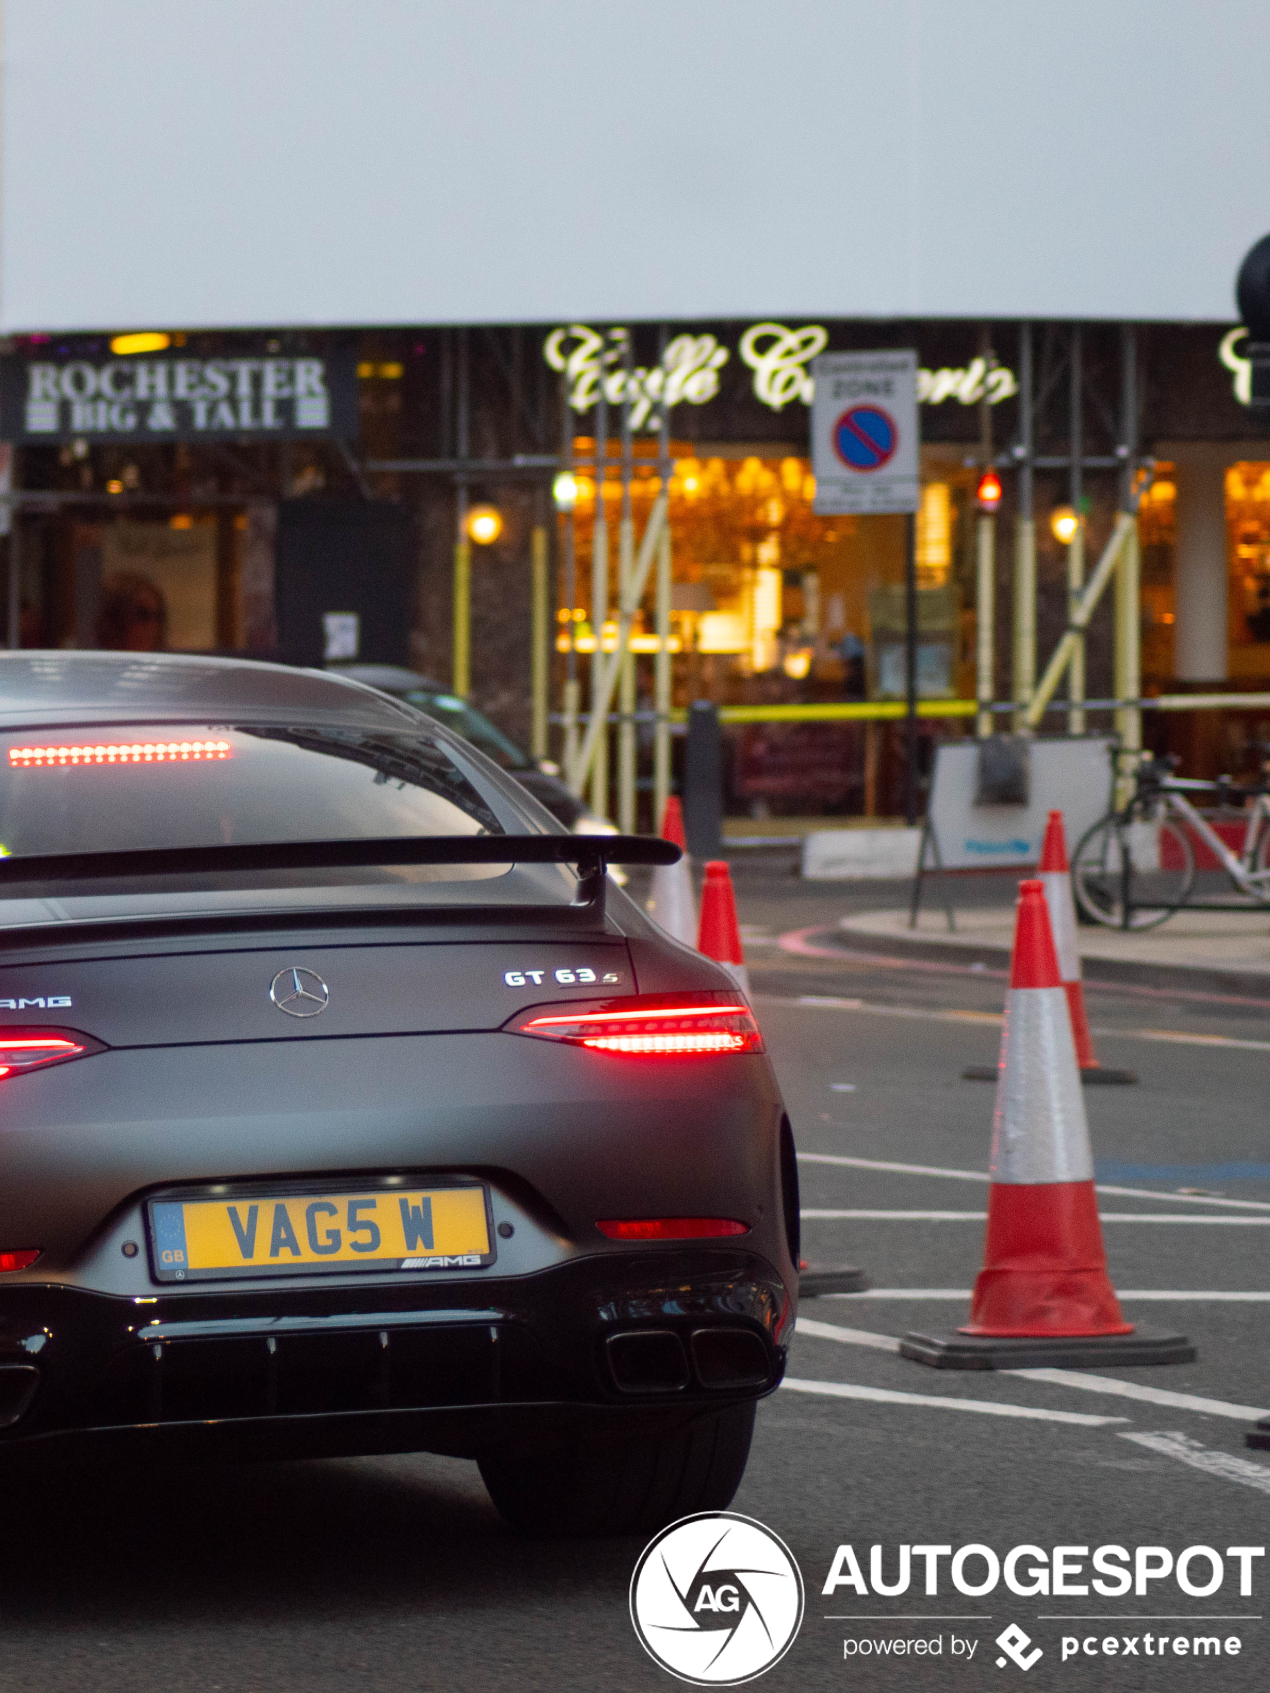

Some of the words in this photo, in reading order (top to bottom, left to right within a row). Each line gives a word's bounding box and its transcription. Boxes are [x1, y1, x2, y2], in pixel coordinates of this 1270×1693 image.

[28, 357, 328, 401] ROCHESTER
[71, 399, 137, 432] BIG
[148, 401, 176, 431] &
[190, 398, 282, 430] TALL
[505, 970, 545, 987] GT
[555, 968, 597, 984] 63
[226, 1198, 382, 1259] VAG5
[398, 1196, 435, 1252] W
[162, 1250, 185, 1264] GB
[426, 1254, 482, 1267] AMG
